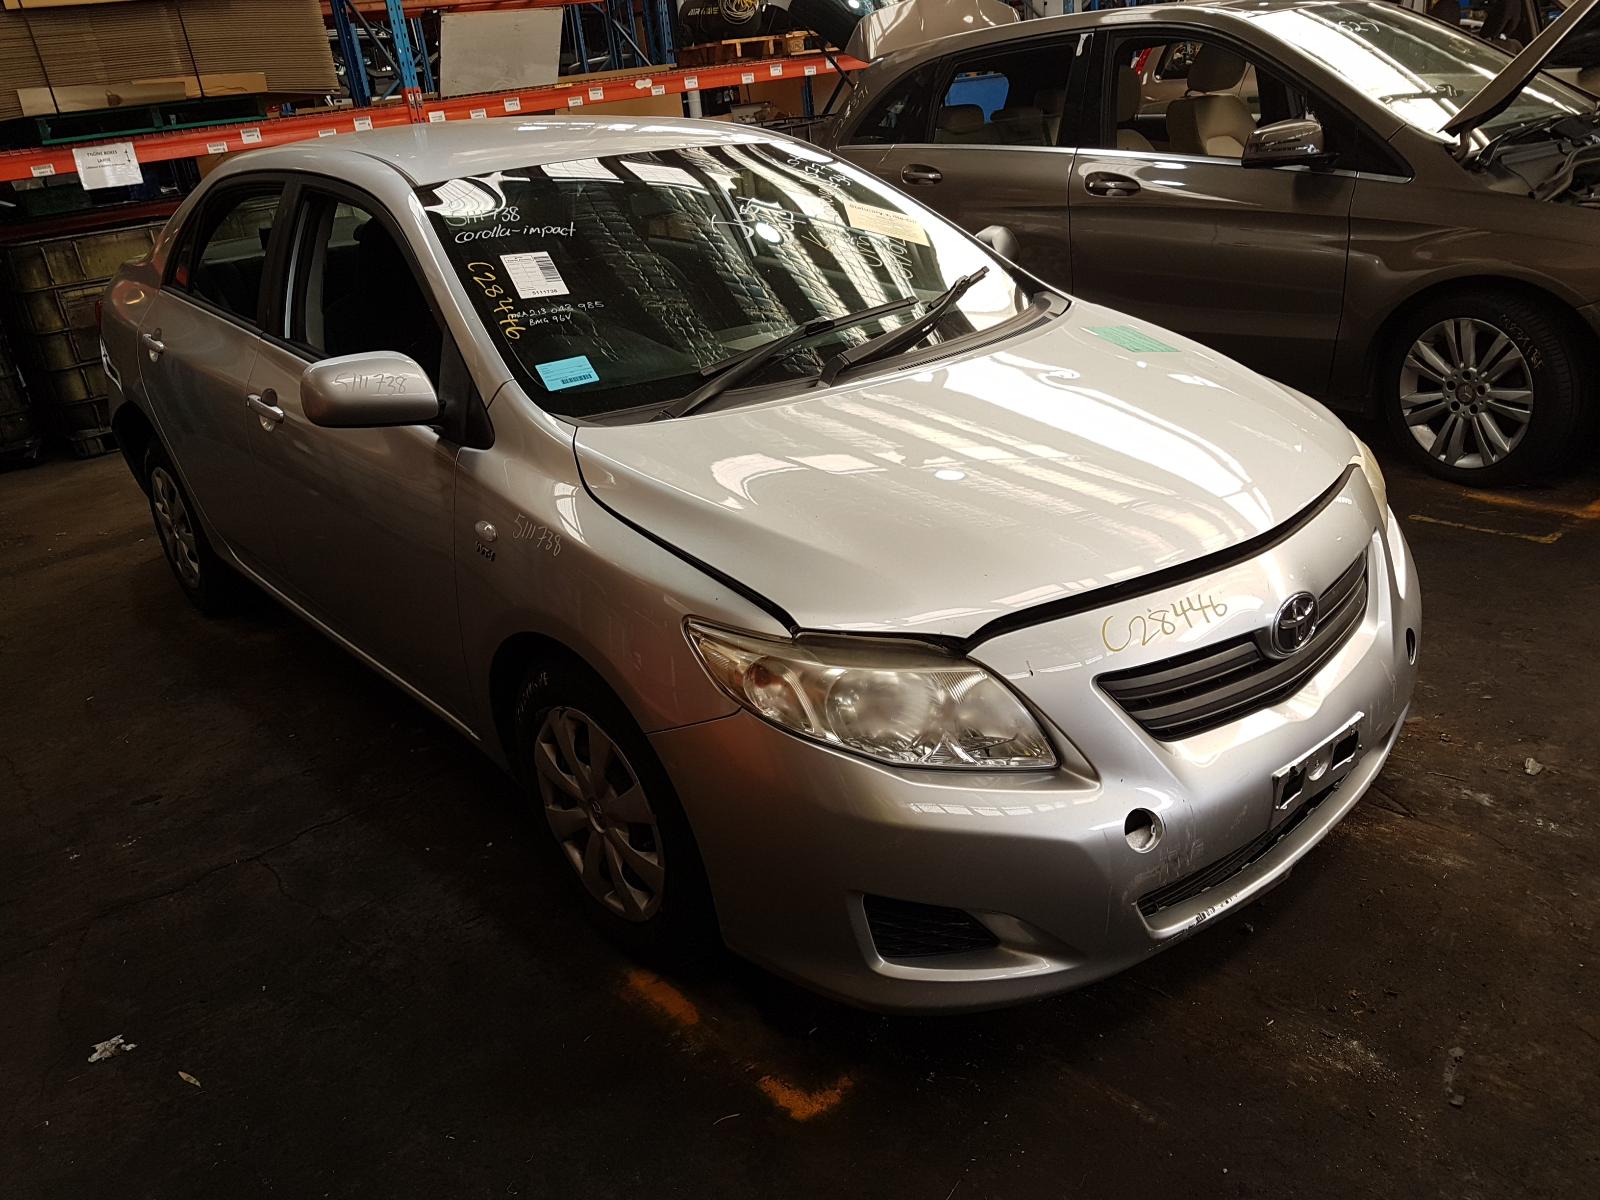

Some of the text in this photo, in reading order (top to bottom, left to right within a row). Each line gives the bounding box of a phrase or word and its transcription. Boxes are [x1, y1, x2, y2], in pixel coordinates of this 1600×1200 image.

[467, 261, 527, 340] C28446
[577, 300, 605, 312] 985
[334, 372, 408, 394] 5111738
[512, 512, 561, 557] 5111738
[1101, 594, 1228, 652] C28446
